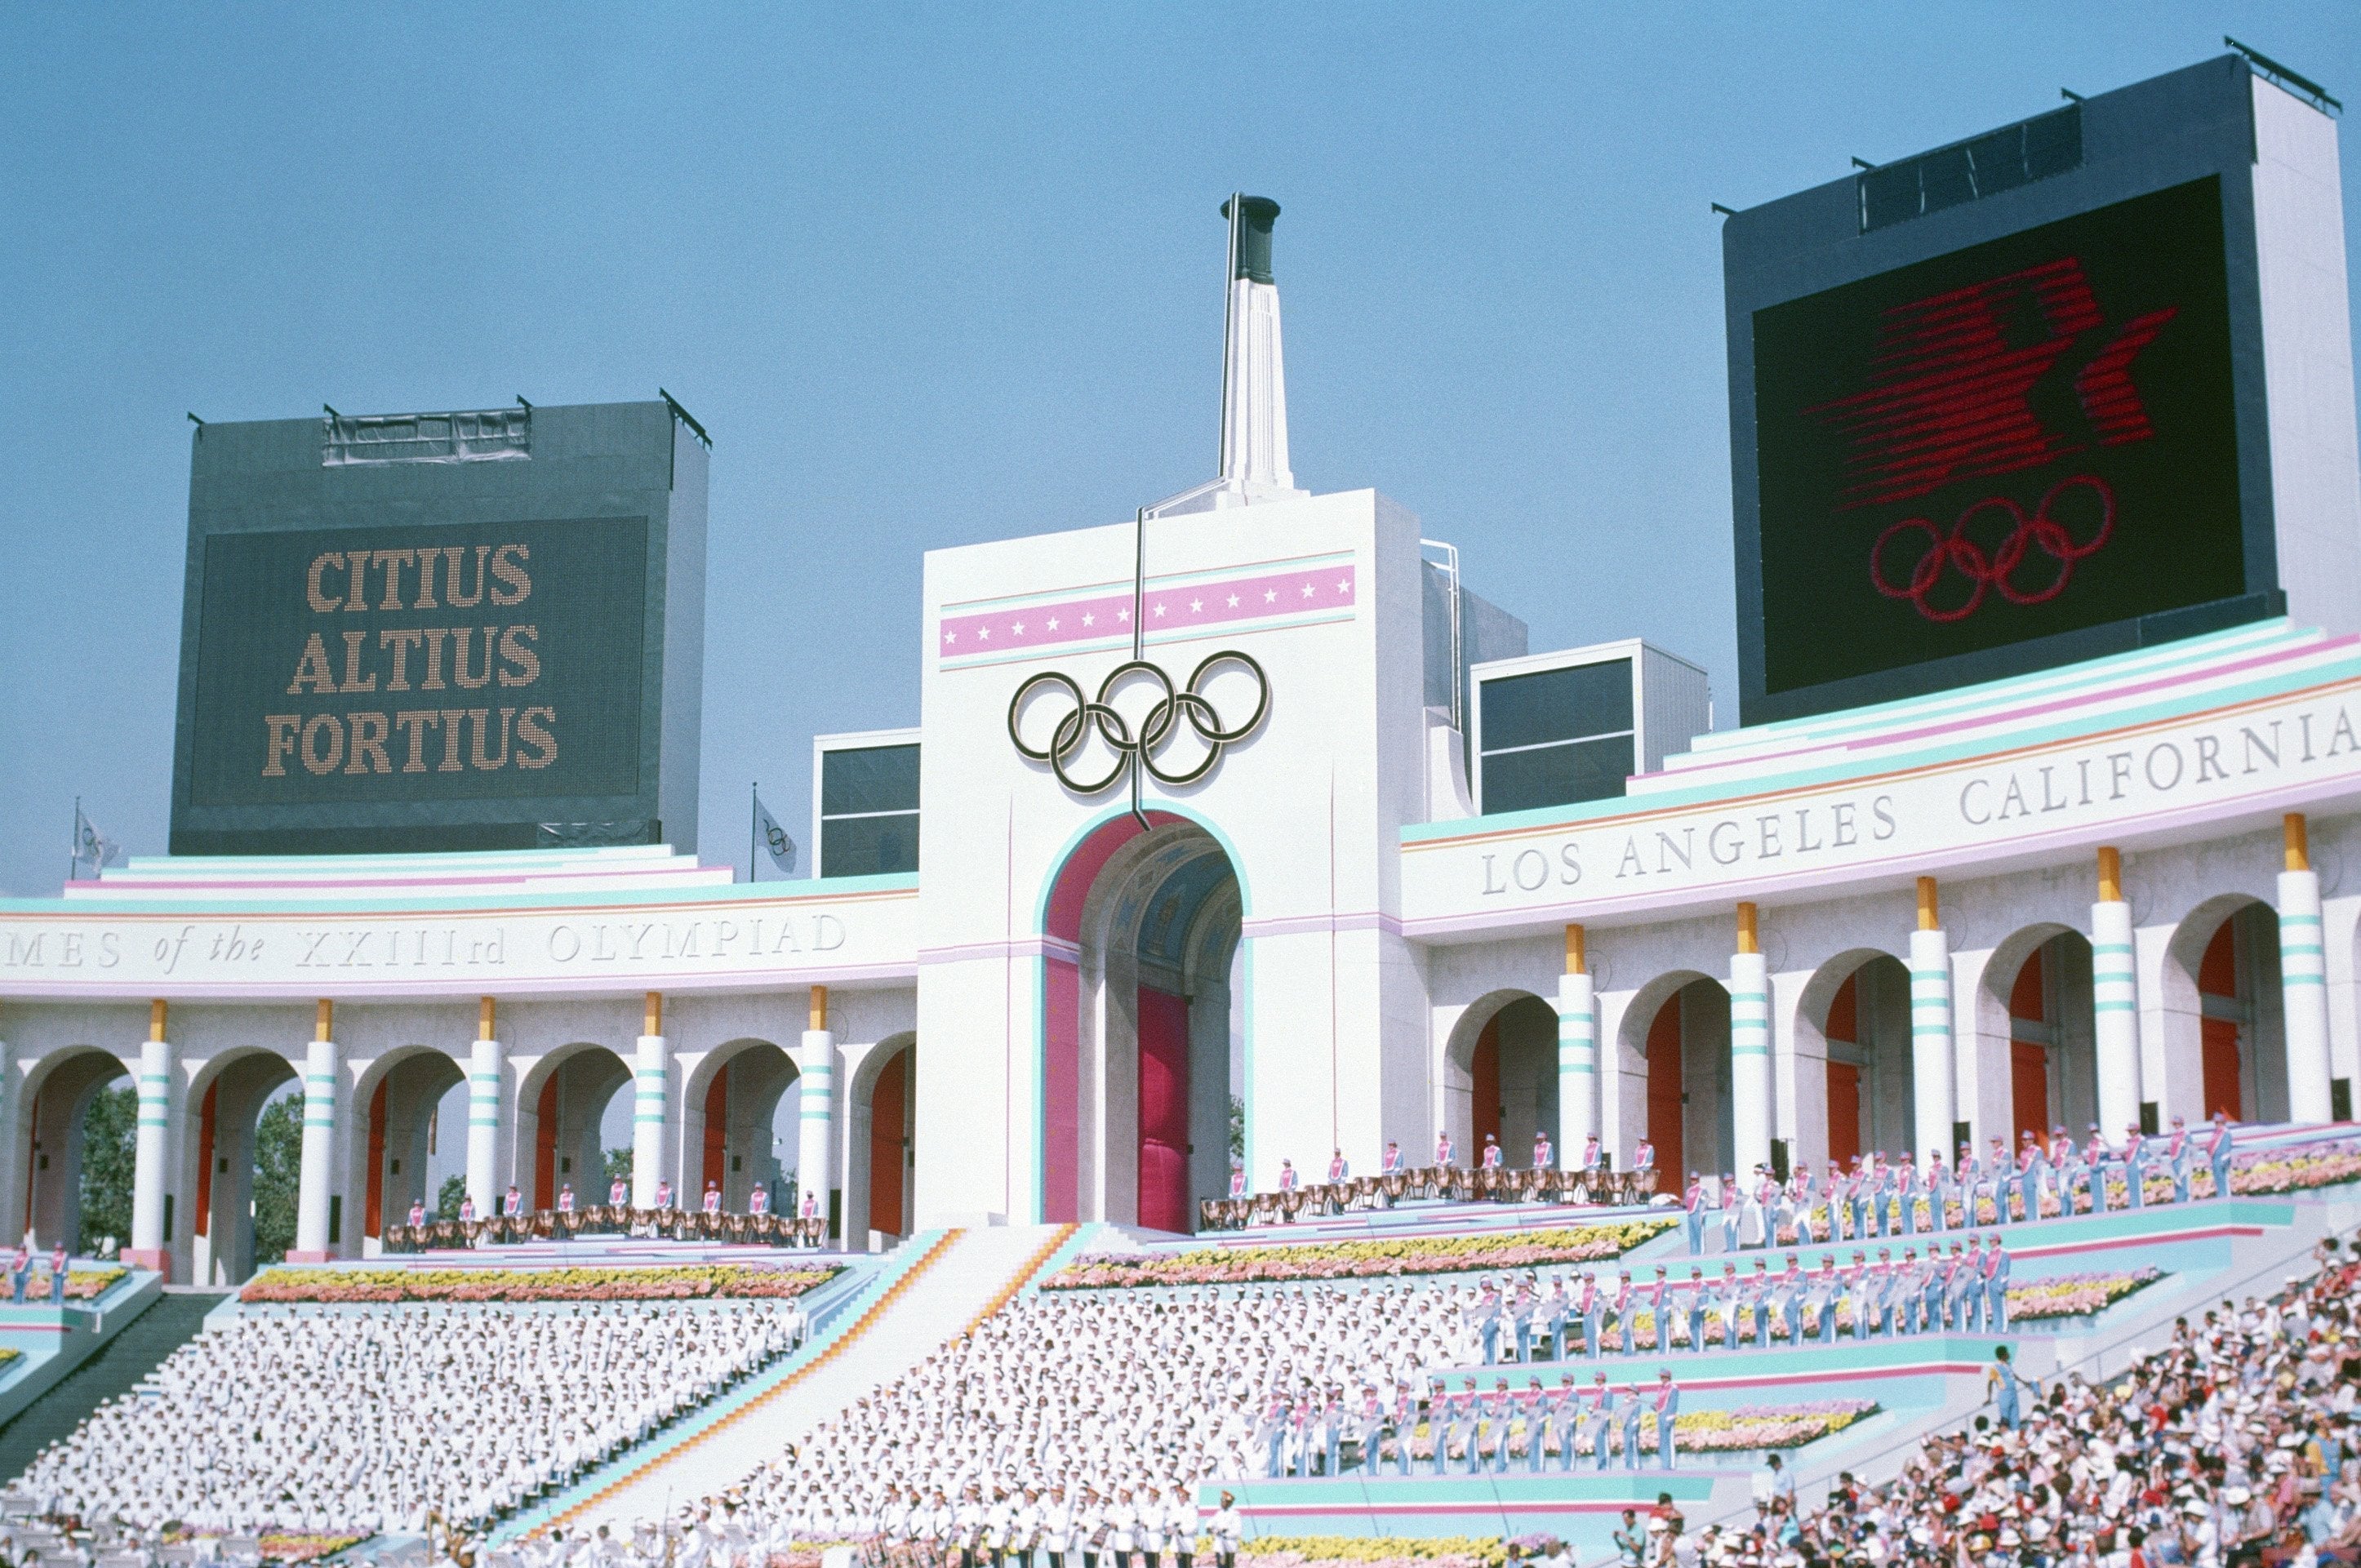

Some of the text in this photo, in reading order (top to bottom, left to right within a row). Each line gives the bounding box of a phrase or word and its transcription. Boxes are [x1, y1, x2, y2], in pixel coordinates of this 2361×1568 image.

[307, 544, 532, 612] CITIUS
[287, 625, 540, 694] ALTIUS
[261, 707, 558, 776] FORTIUS
[1482, 705, 2361, 896] LOS ANGELES CALIFORNIA
[3, 914, 847, 975] MES of the XXIIIrd OLYMPIAD
